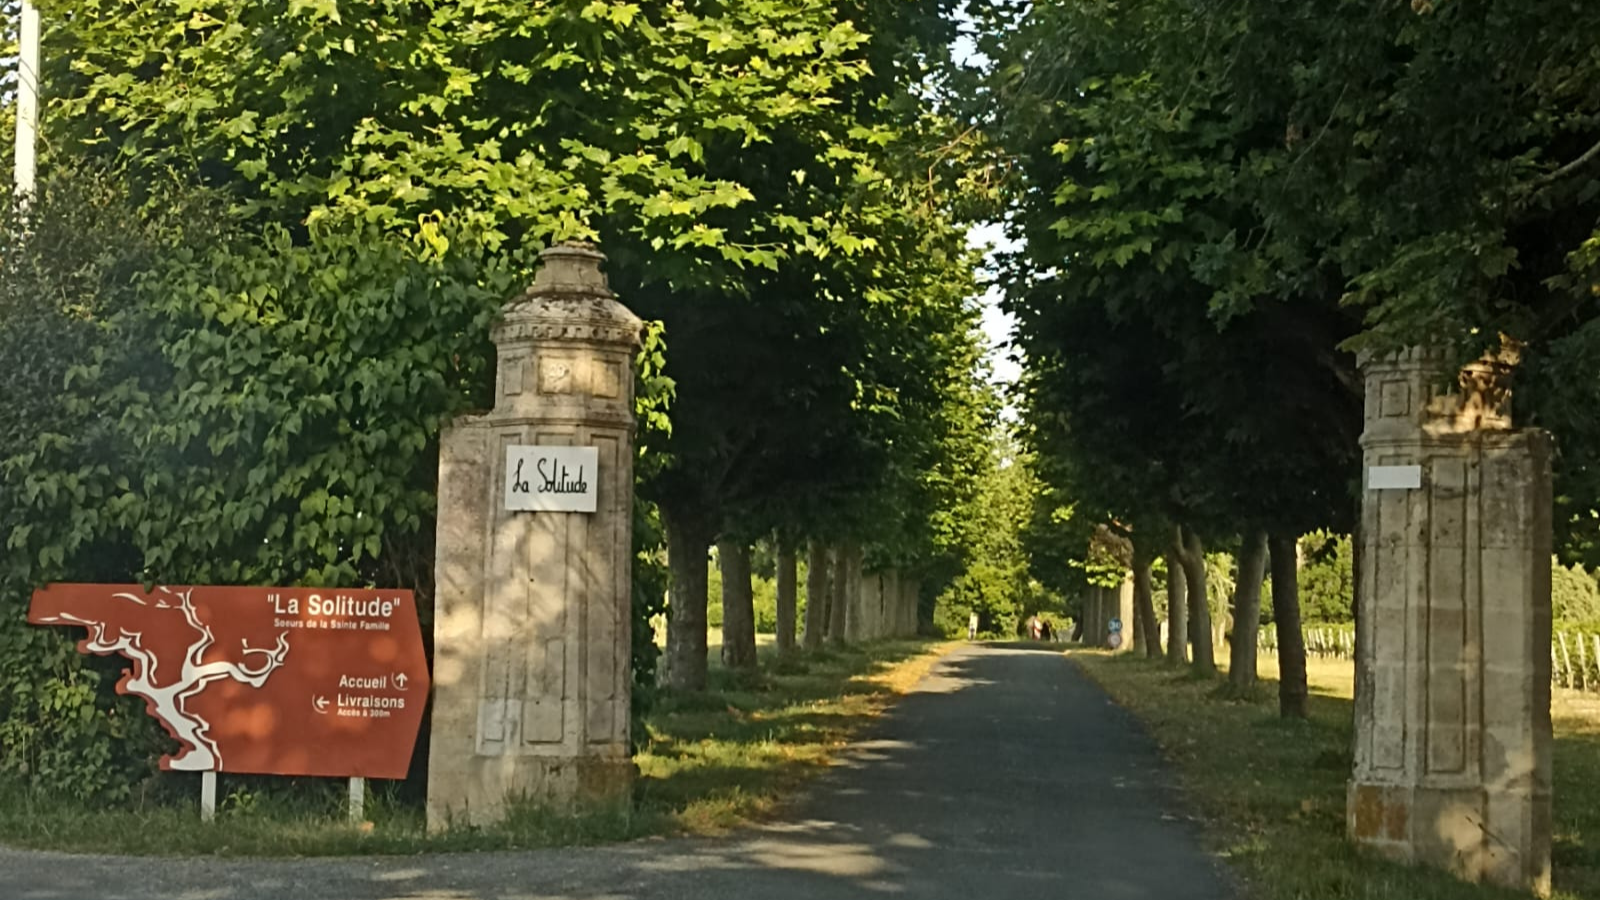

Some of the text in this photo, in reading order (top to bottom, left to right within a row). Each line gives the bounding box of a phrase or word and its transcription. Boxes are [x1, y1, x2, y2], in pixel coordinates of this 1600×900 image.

[512, 457, 588, 494] La Solitude
[267, 593, 400, 617] "La Solitude"
[306, 619, 317, 629] de
[319, 619, 328, 629] la
[330, 619, 357, 629] Sainte
[360, 620, 390, 631] Famille
[339, 674, 387, 689] Accueil
[337, 693, 405, 709] Livraisons
